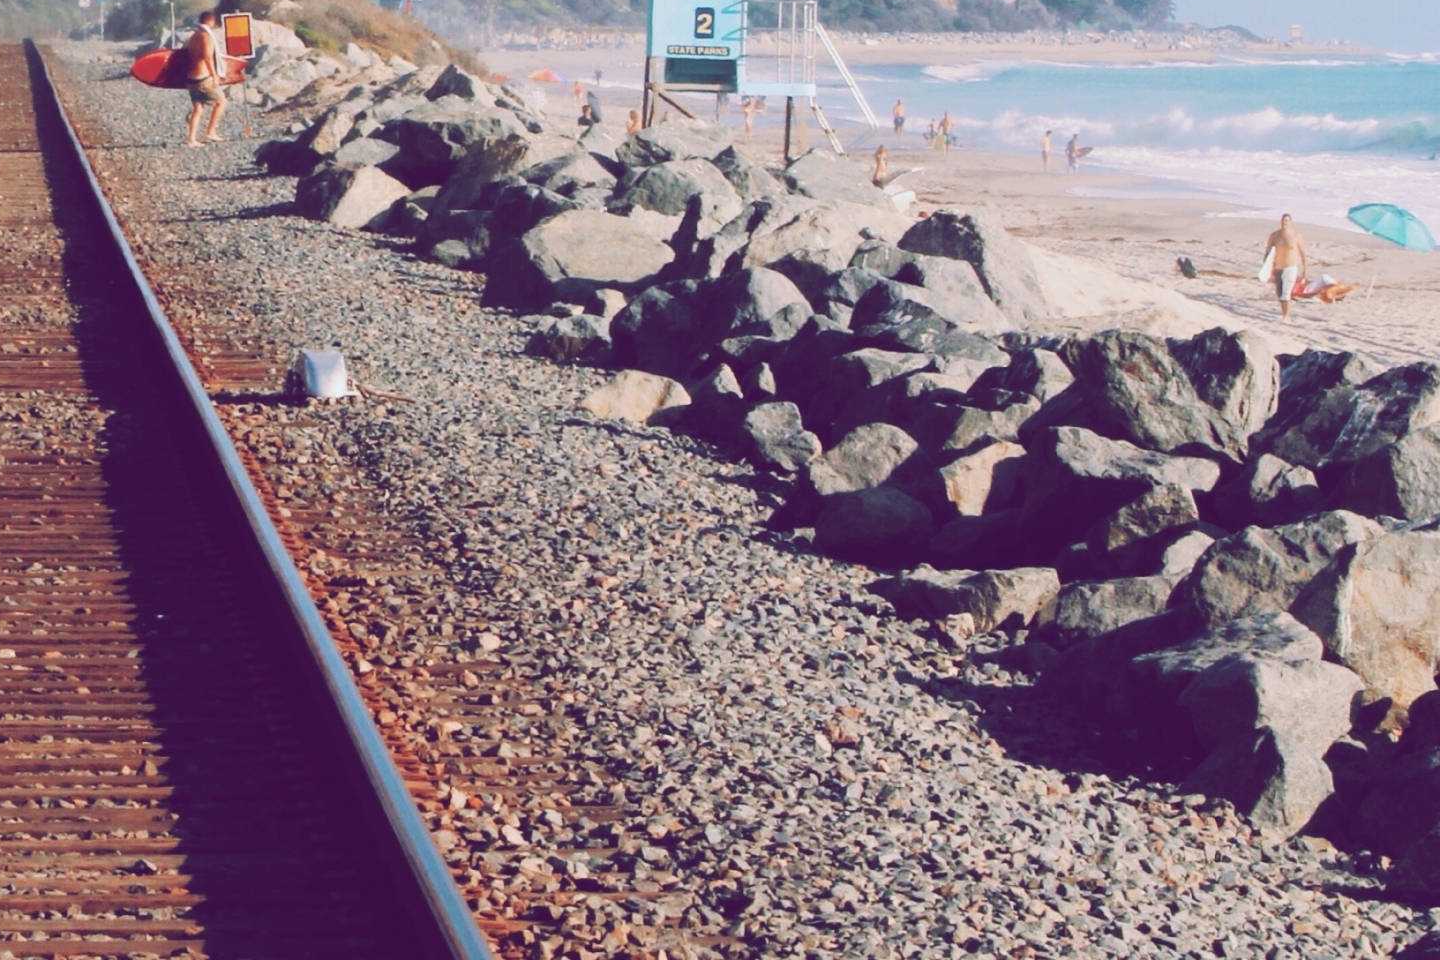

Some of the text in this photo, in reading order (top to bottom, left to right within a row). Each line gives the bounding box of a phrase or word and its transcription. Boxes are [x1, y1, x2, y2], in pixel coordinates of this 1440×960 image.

[696, 13, 713, 35] 2
[668, 45, 728, 55] STATE PARKS
